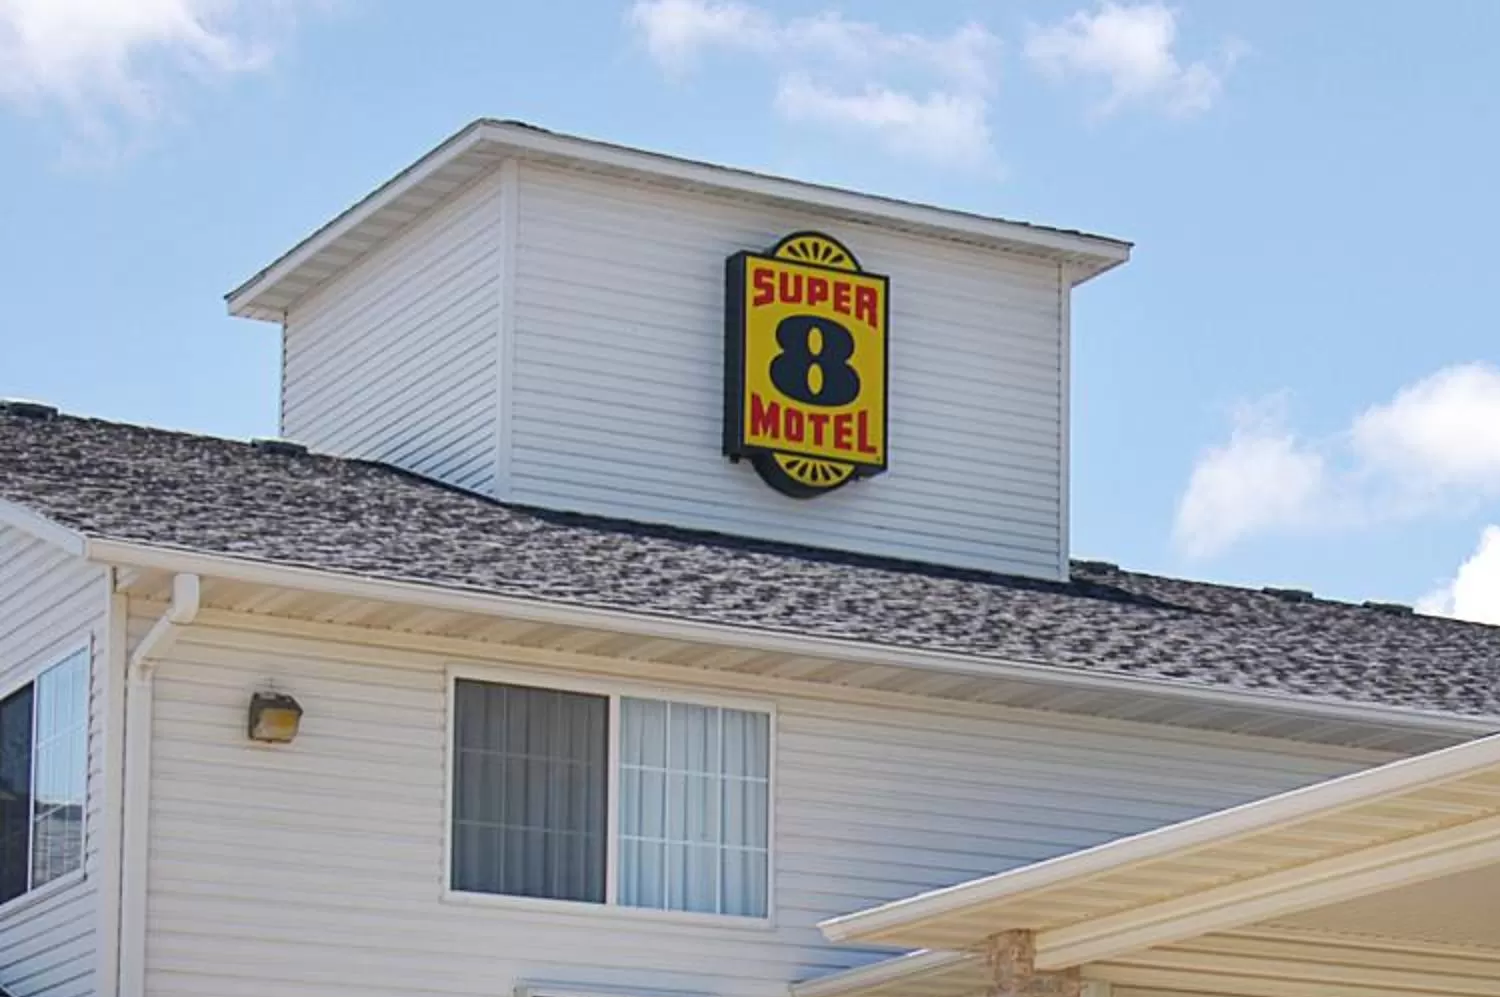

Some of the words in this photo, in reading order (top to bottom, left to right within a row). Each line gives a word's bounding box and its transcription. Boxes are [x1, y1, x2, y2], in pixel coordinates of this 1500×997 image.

[752, 267, 878, 328] SUPER
[769, 314, 861, 407] 8
[751, 391, 878, 454] MOTEL
